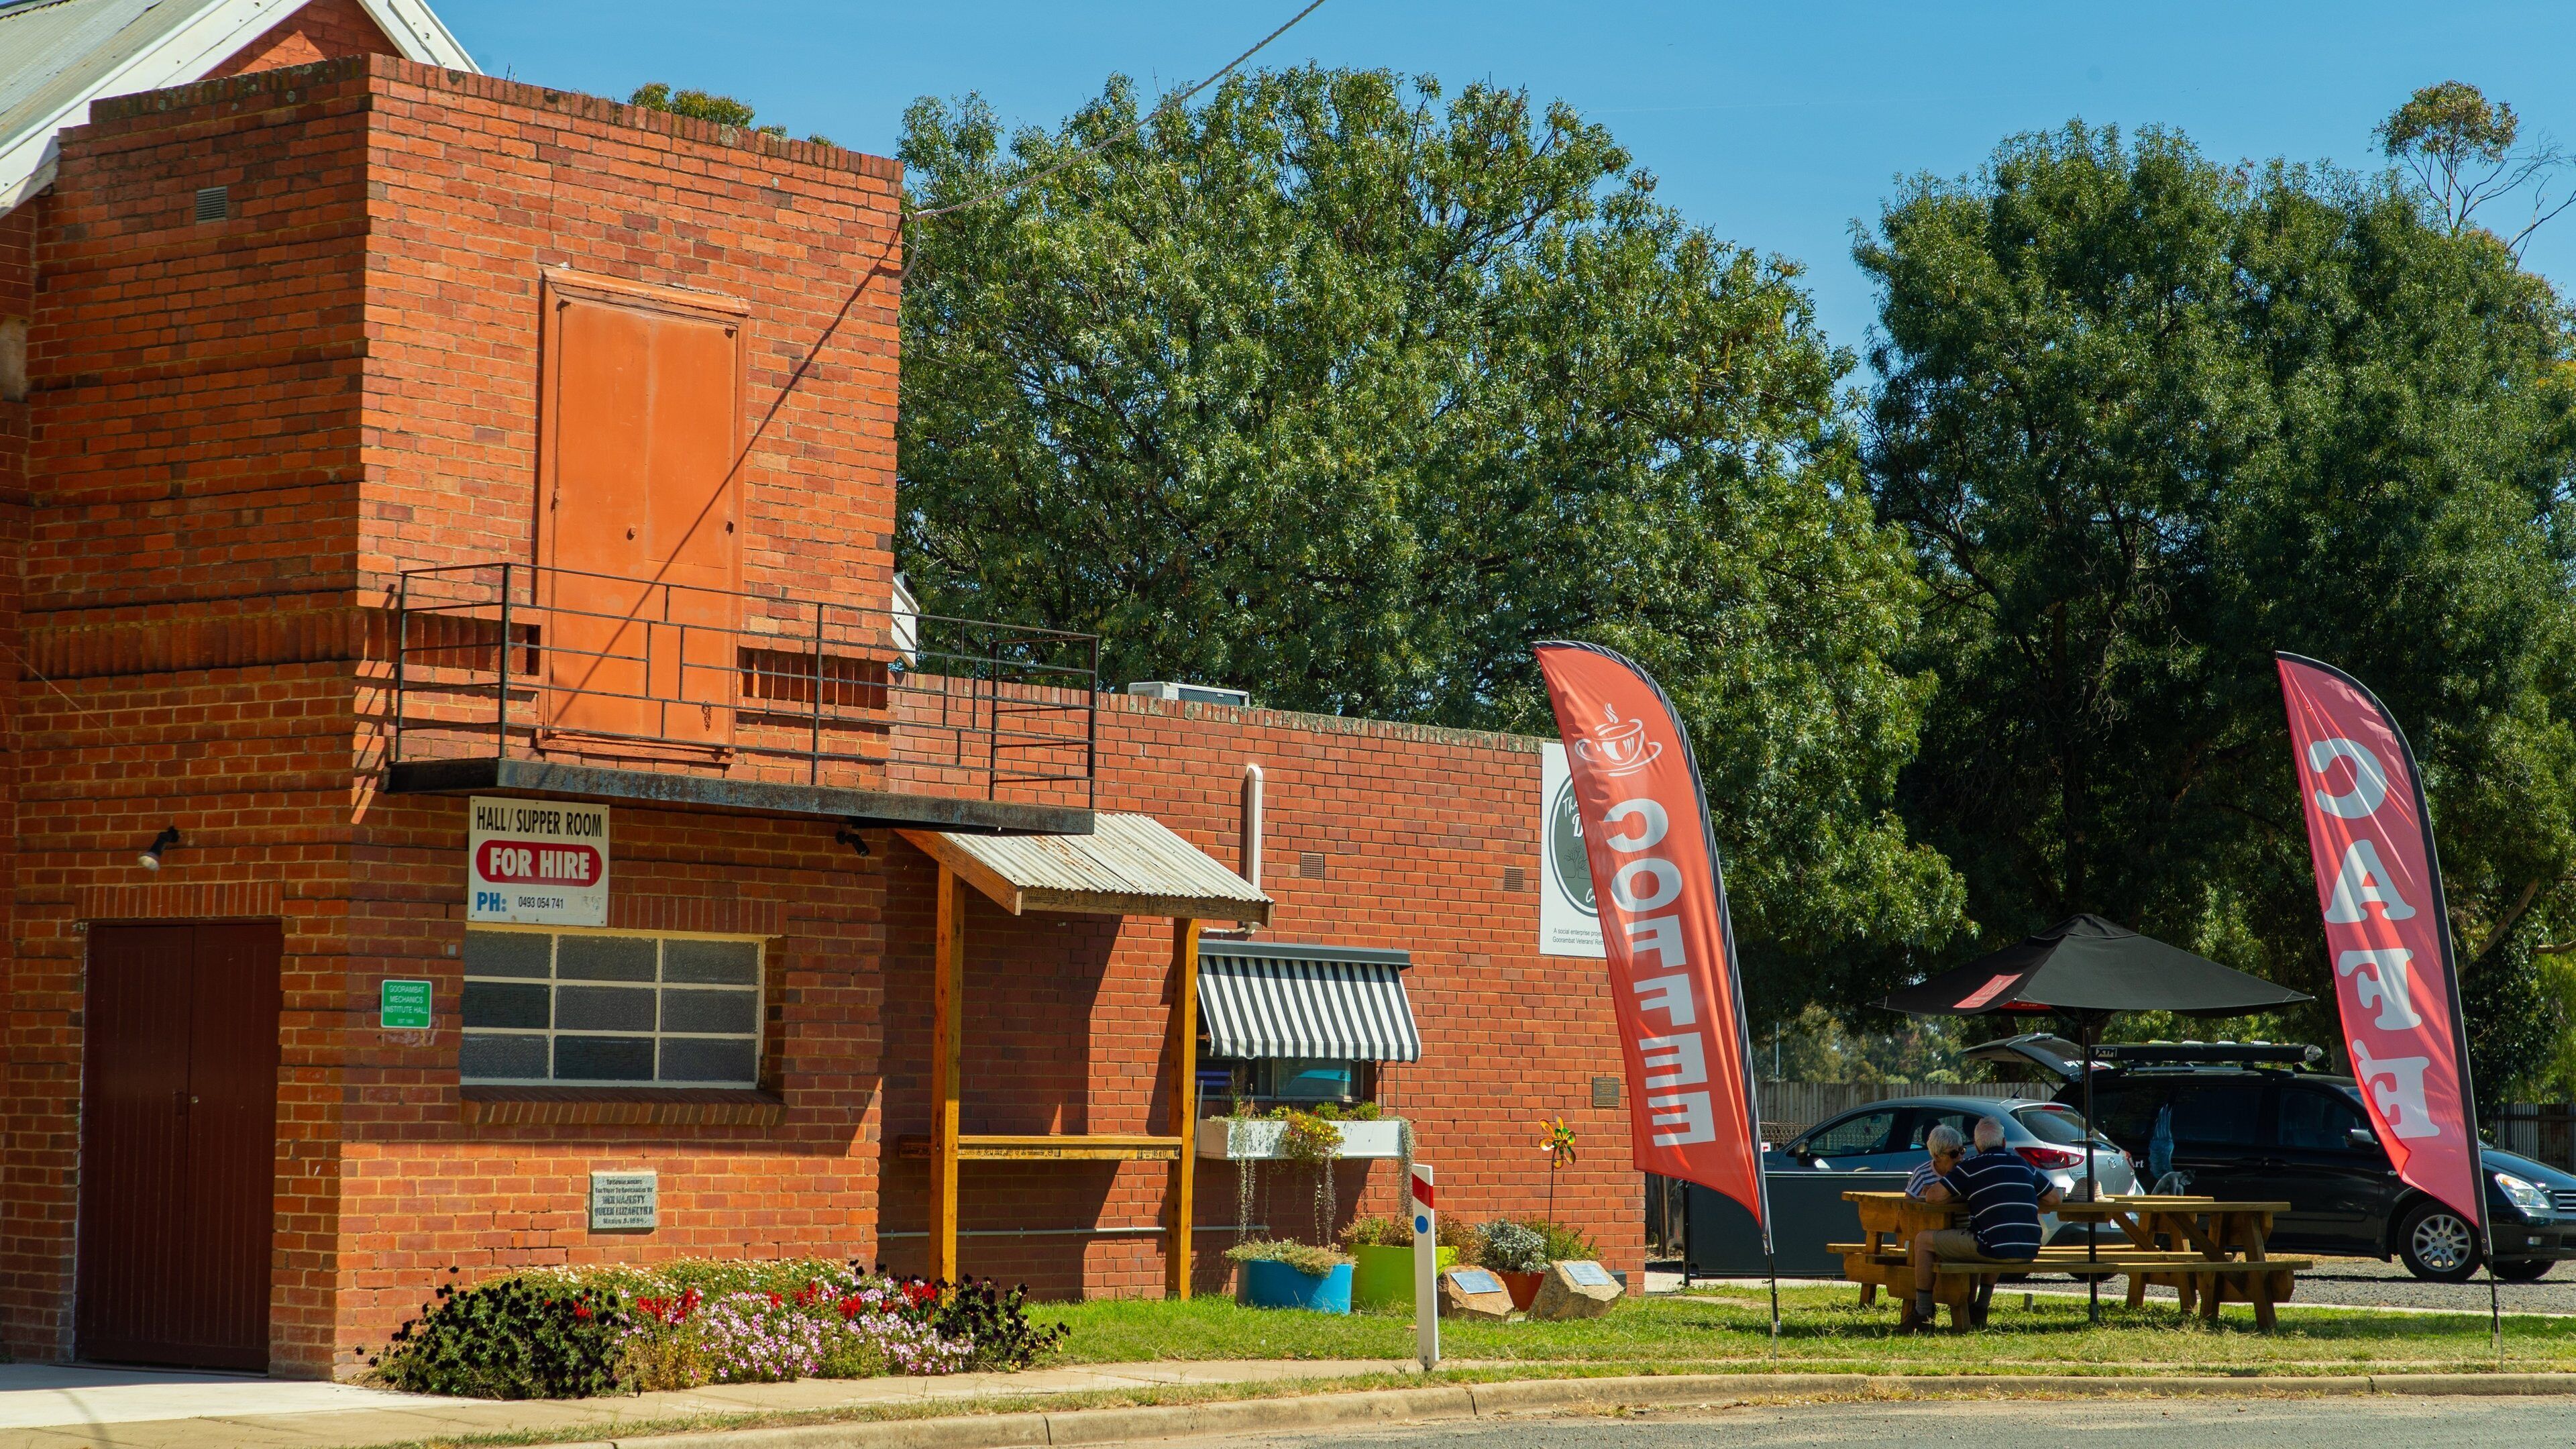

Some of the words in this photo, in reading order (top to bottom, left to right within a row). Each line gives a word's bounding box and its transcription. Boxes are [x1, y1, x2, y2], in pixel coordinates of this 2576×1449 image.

[566, 812, 602, 837] ROOM
[490, 847, 533, 877] FOR
[539, 850, 590, 879] HIRE
[476, 892, 507, 912] PH:
[518, 896, 535, 908] 0493
[537, 897, 549, 908] 054
[551, 898, 564, 909] 741
[389, 985, 425, 993] GOORAMBAT
[390, 996, 423, 1004] MECHANICS
[384, 1006, 412, 1014] INSTITUTE
[413, 1006, 427, 1014] HALL
[2132, 1159, 2144, 1168] rt
[616, 1195, 646, 1203] MAJESTY
[594, 1207, 614, 1217] QUEEN
[615, 1206, 648, 1216] ELIZABETH
